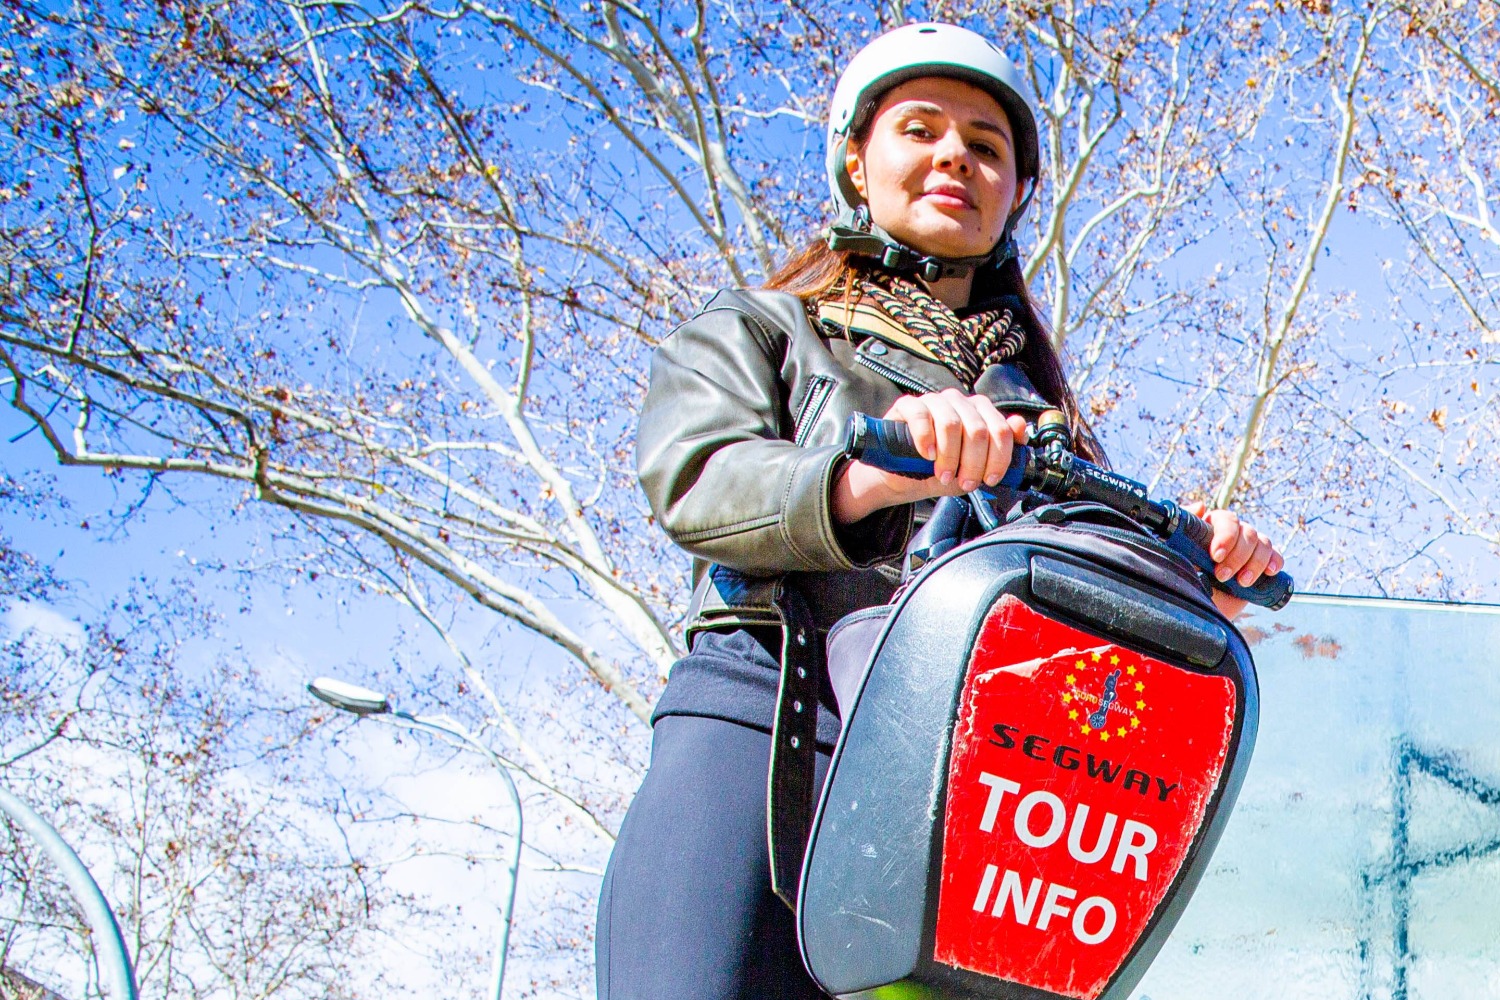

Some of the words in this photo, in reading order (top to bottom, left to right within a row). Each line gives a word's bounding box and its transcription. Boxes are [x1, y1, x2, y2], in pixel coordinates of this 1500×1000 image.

[1085, 467, 1133, 492] SEGWAY
[1098, 699, 1135, 716] SEGWAY
[989, 723, 1179, 802] SEGWAY
[978, 772, 1158, 881] TOUR
[972, 866, 1117, 945] INFO
